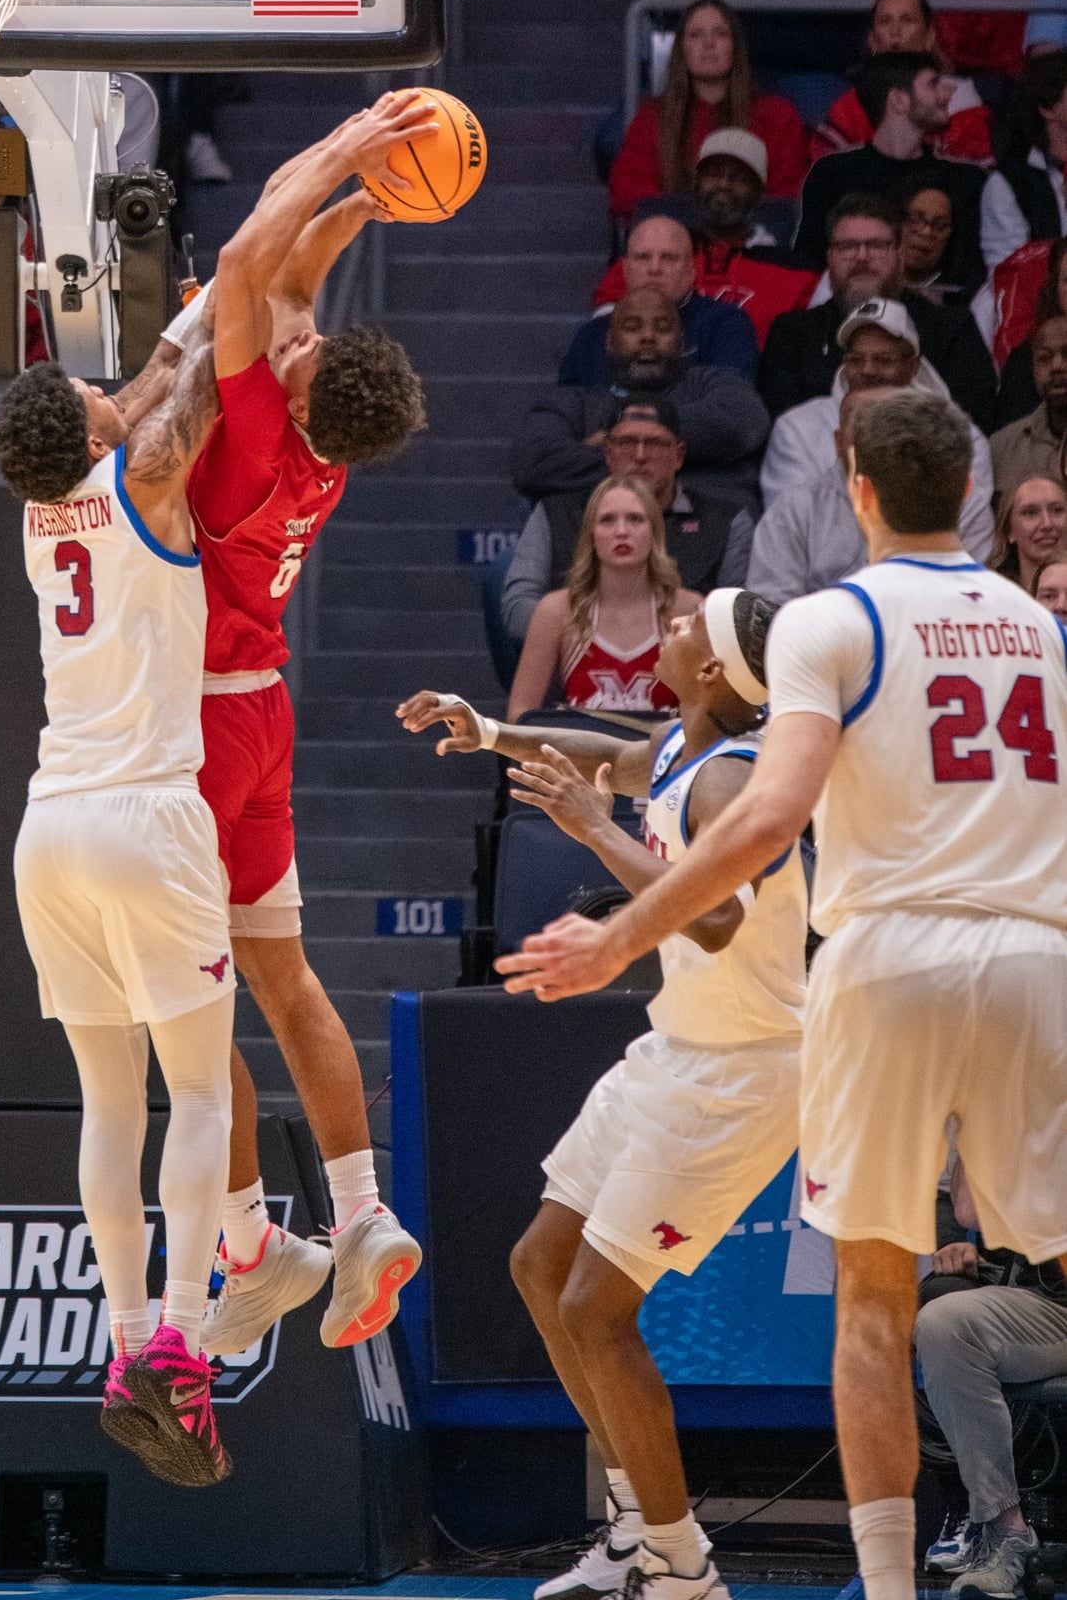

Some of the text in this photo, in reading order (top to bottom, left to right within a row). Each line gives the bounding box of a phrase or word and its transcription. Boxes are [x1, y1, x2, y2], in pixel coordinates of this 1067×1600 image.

[27, 495, 112, 537] WASHINGTON
[54, 539, 94, 637] 3
[914, 616, 1043, 659] YIĞITOĞLU
[926, 673, 1059, 784] 24
[394, 900, 445, 934] 101
